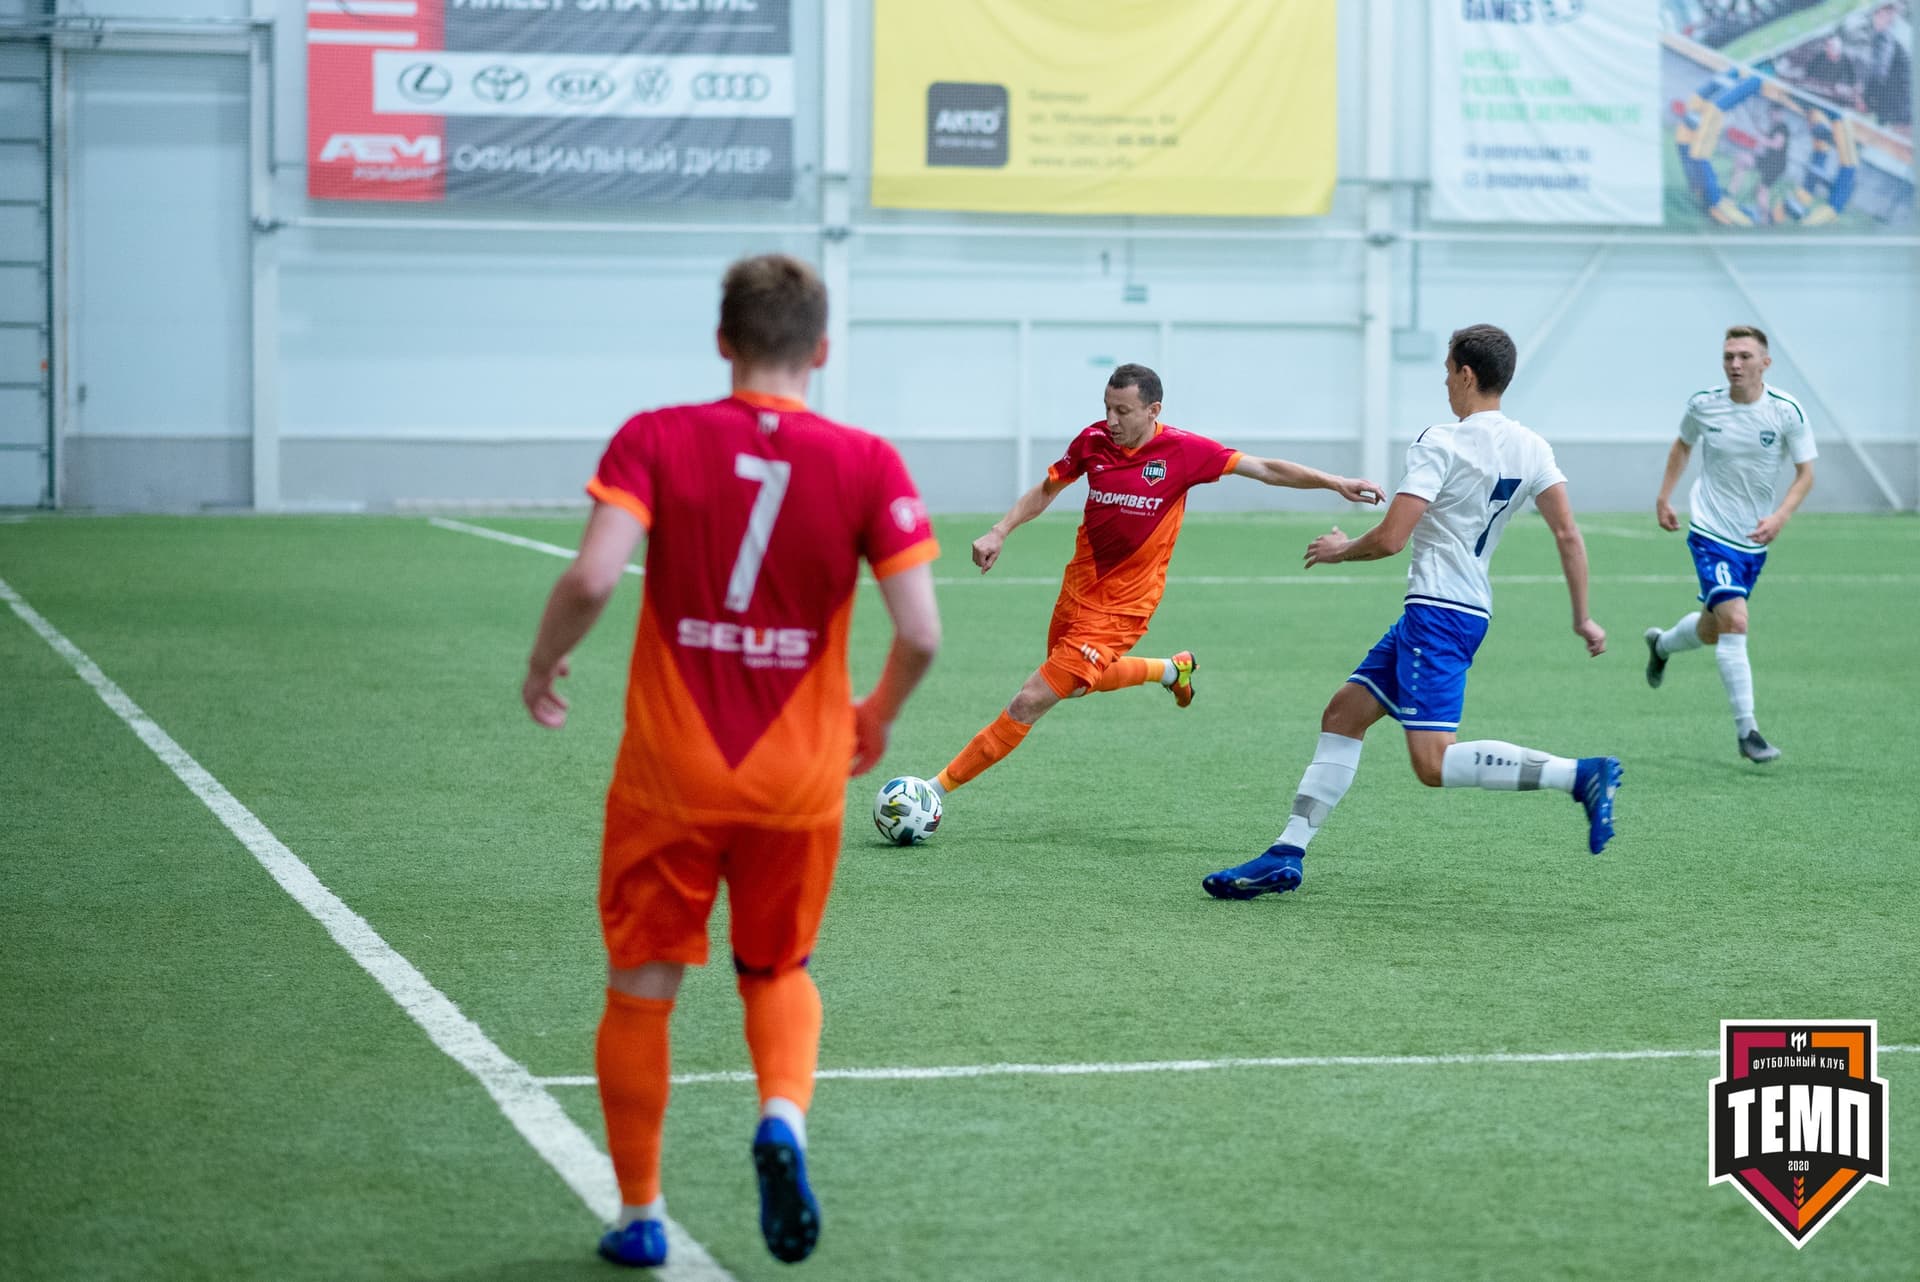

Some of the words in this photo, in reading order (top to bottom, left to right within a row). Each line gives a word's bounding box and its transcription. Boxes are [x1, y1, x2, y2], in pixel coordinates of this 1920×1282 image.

[453, 143, 677, 174] ОФИЦИАЛЬНЫЙ
[681, 146, 773, 175] ДИЛЕР
[1089, 488, 1163, 511] РОДИНВЕСТ
[1474, 472, 1522, 557] 7
[724, 453, 791, 613] 7
[1715, 561, 1732, 586] 6
[678, 618, 809, 657] SEUS
